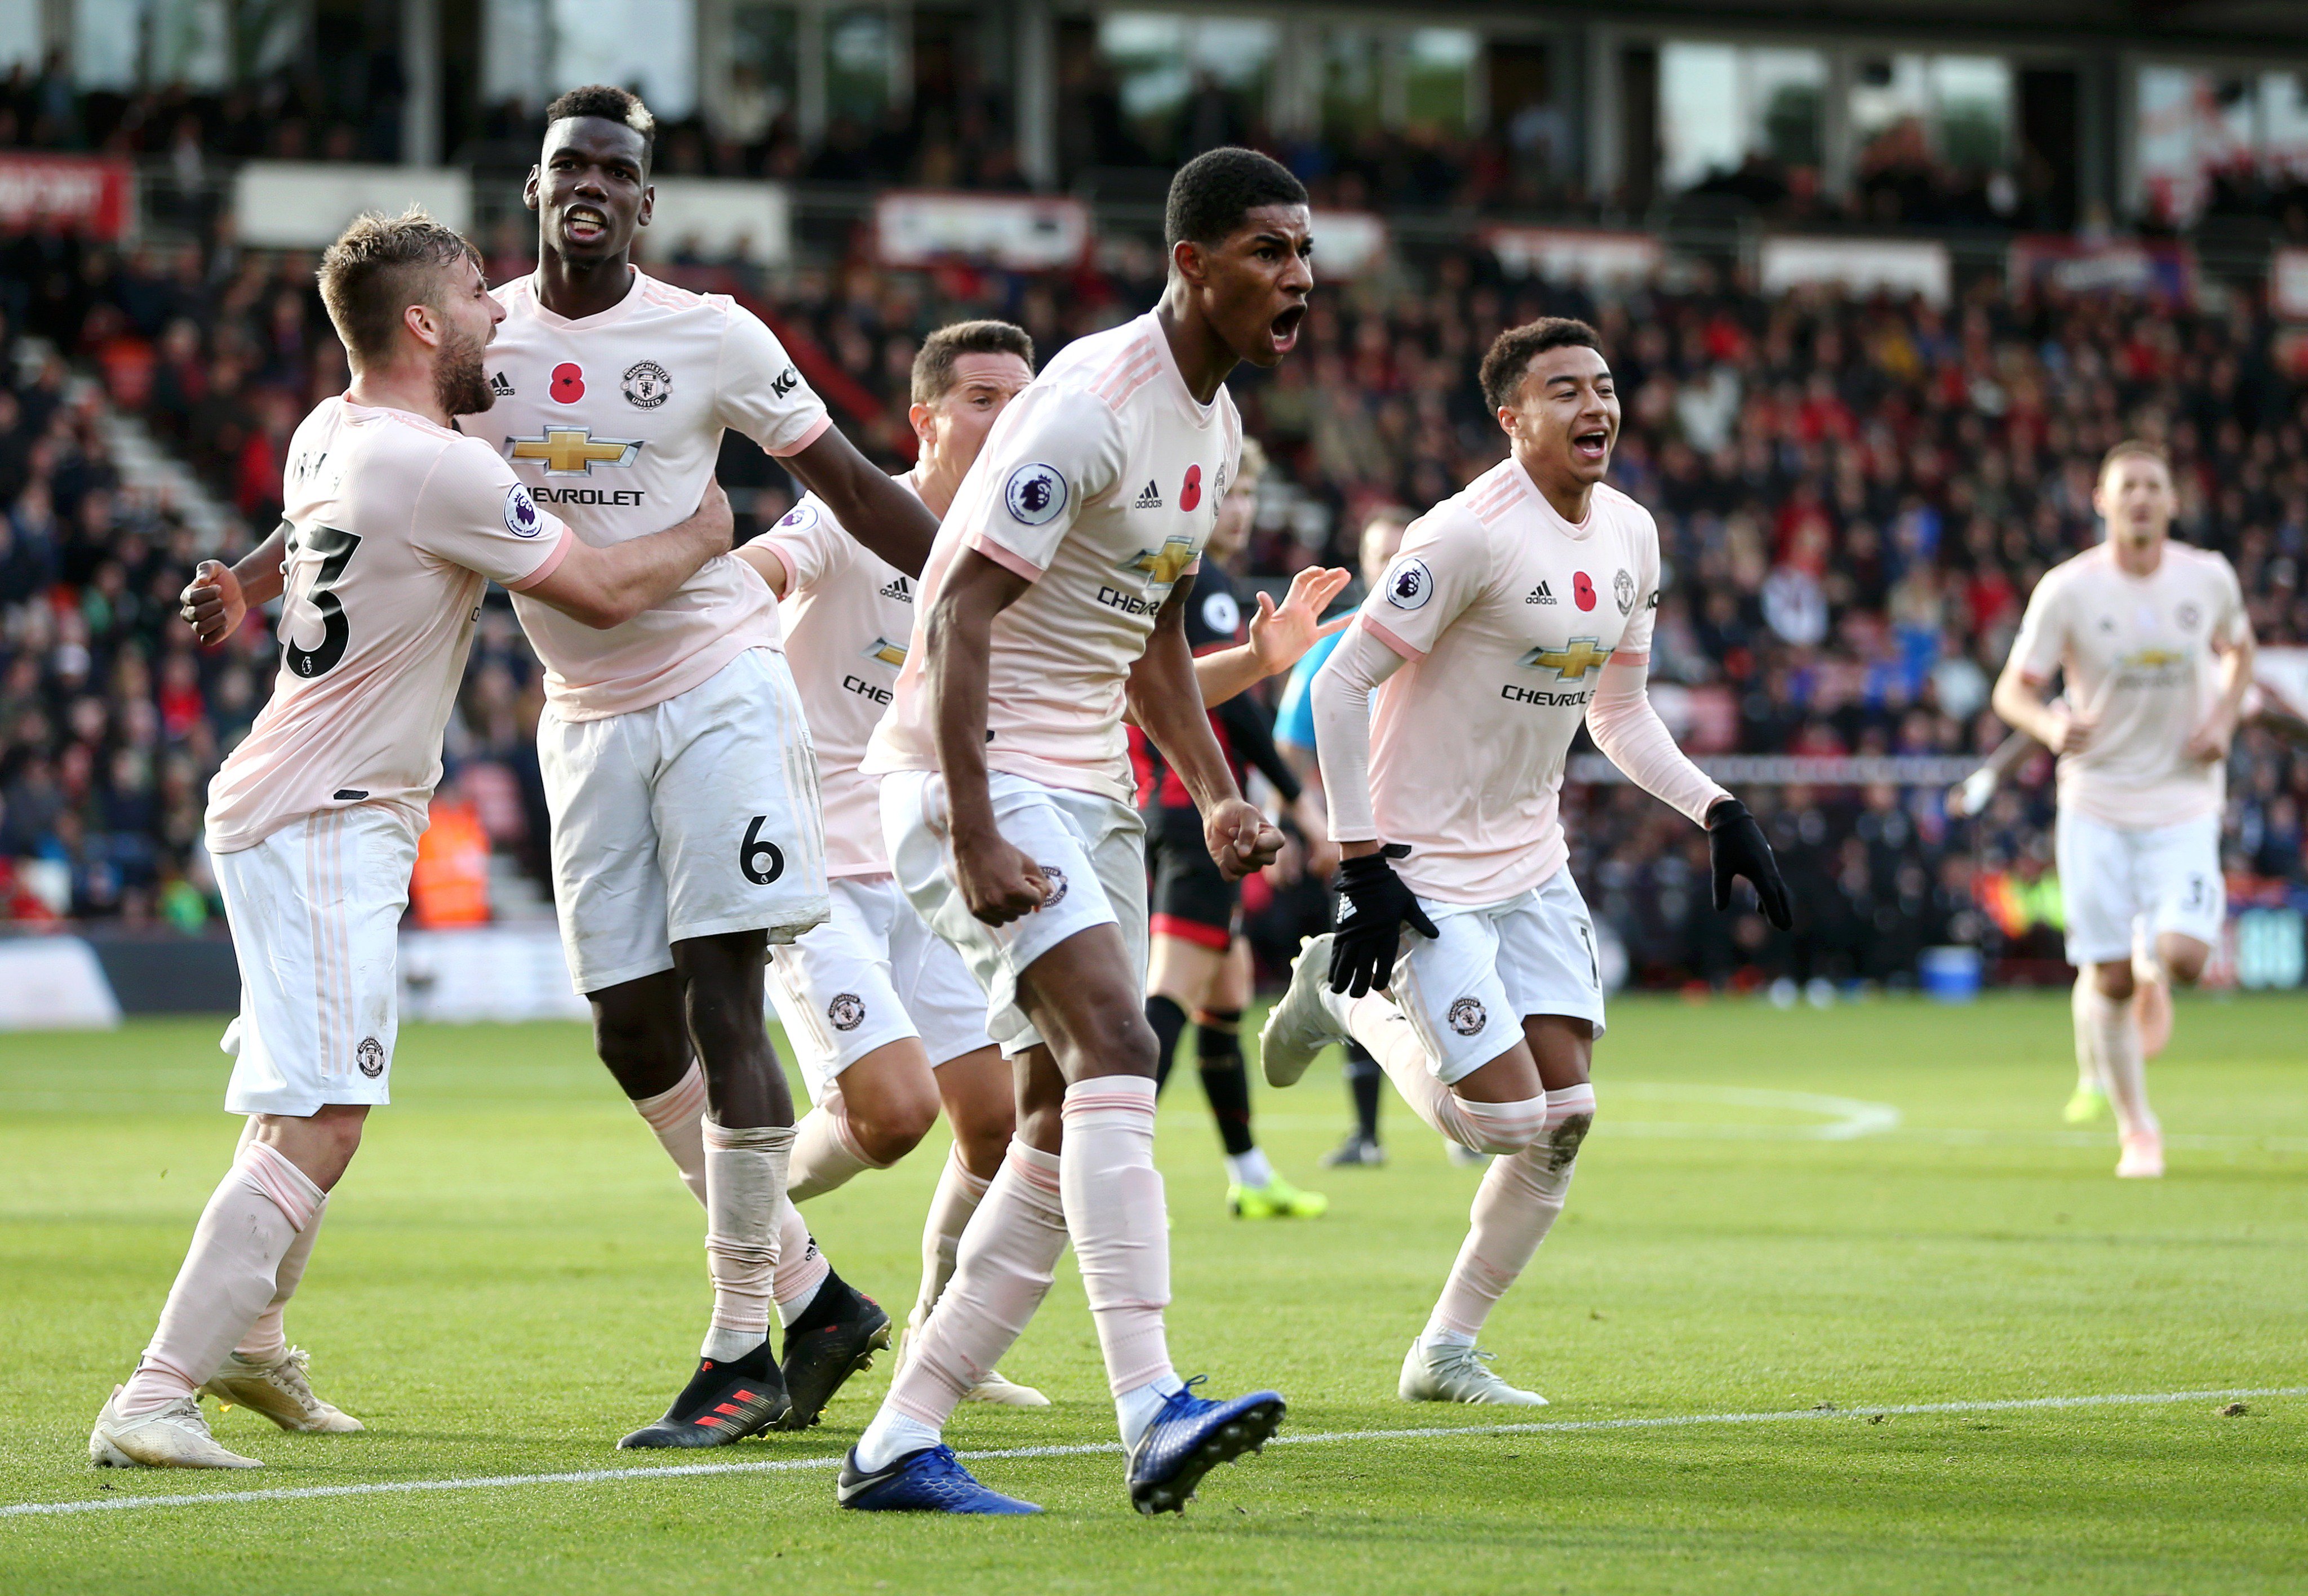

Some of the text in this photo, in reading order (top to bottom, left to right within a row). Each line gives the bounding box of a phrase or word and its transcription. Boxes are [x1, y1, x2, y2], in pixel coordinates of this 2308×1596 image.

[625, 363, 669, 382] MANCHESTER
[632, 397, 662, 406] UNITED
[527, 487, 645, 506] EVROLET
[1135, 498, 1162, 509] adidas
[280, 517, 363, 678] 3
[880, 588, 912, 604] adidas
[1525, 595, 1557, 605] adidas
[738, 815, 785, 886] 6
